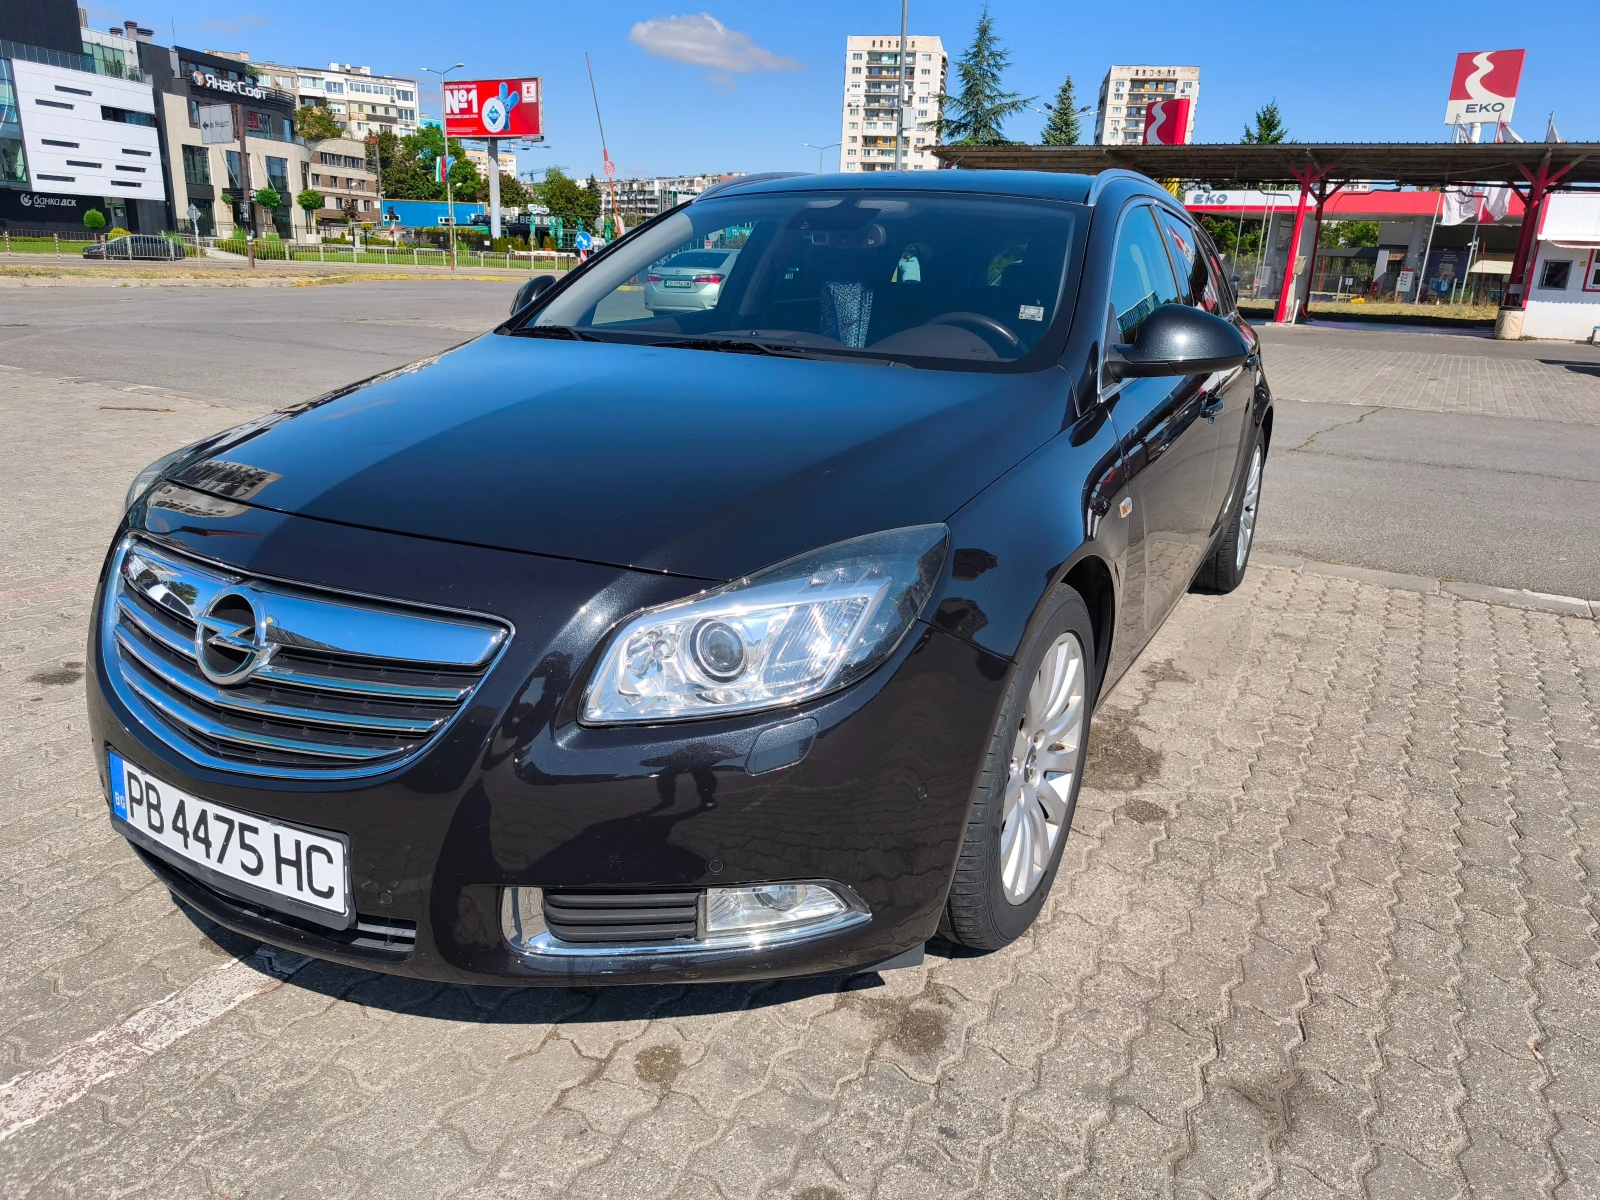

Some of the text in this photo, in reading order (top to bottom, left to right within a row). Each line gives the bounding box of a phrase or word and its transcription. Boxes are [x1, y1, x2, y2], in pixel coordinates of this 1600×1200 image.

[205, 74, 267, 99] Янак Софт
[1465, 102, 1505, 113] EKO
[33, 195, 60, 206] банка
[1193, 193, 1228, 204] EKO
[115, 791, 126, 809] BG
[127, 770, 335, 899] PB 4475 HC
